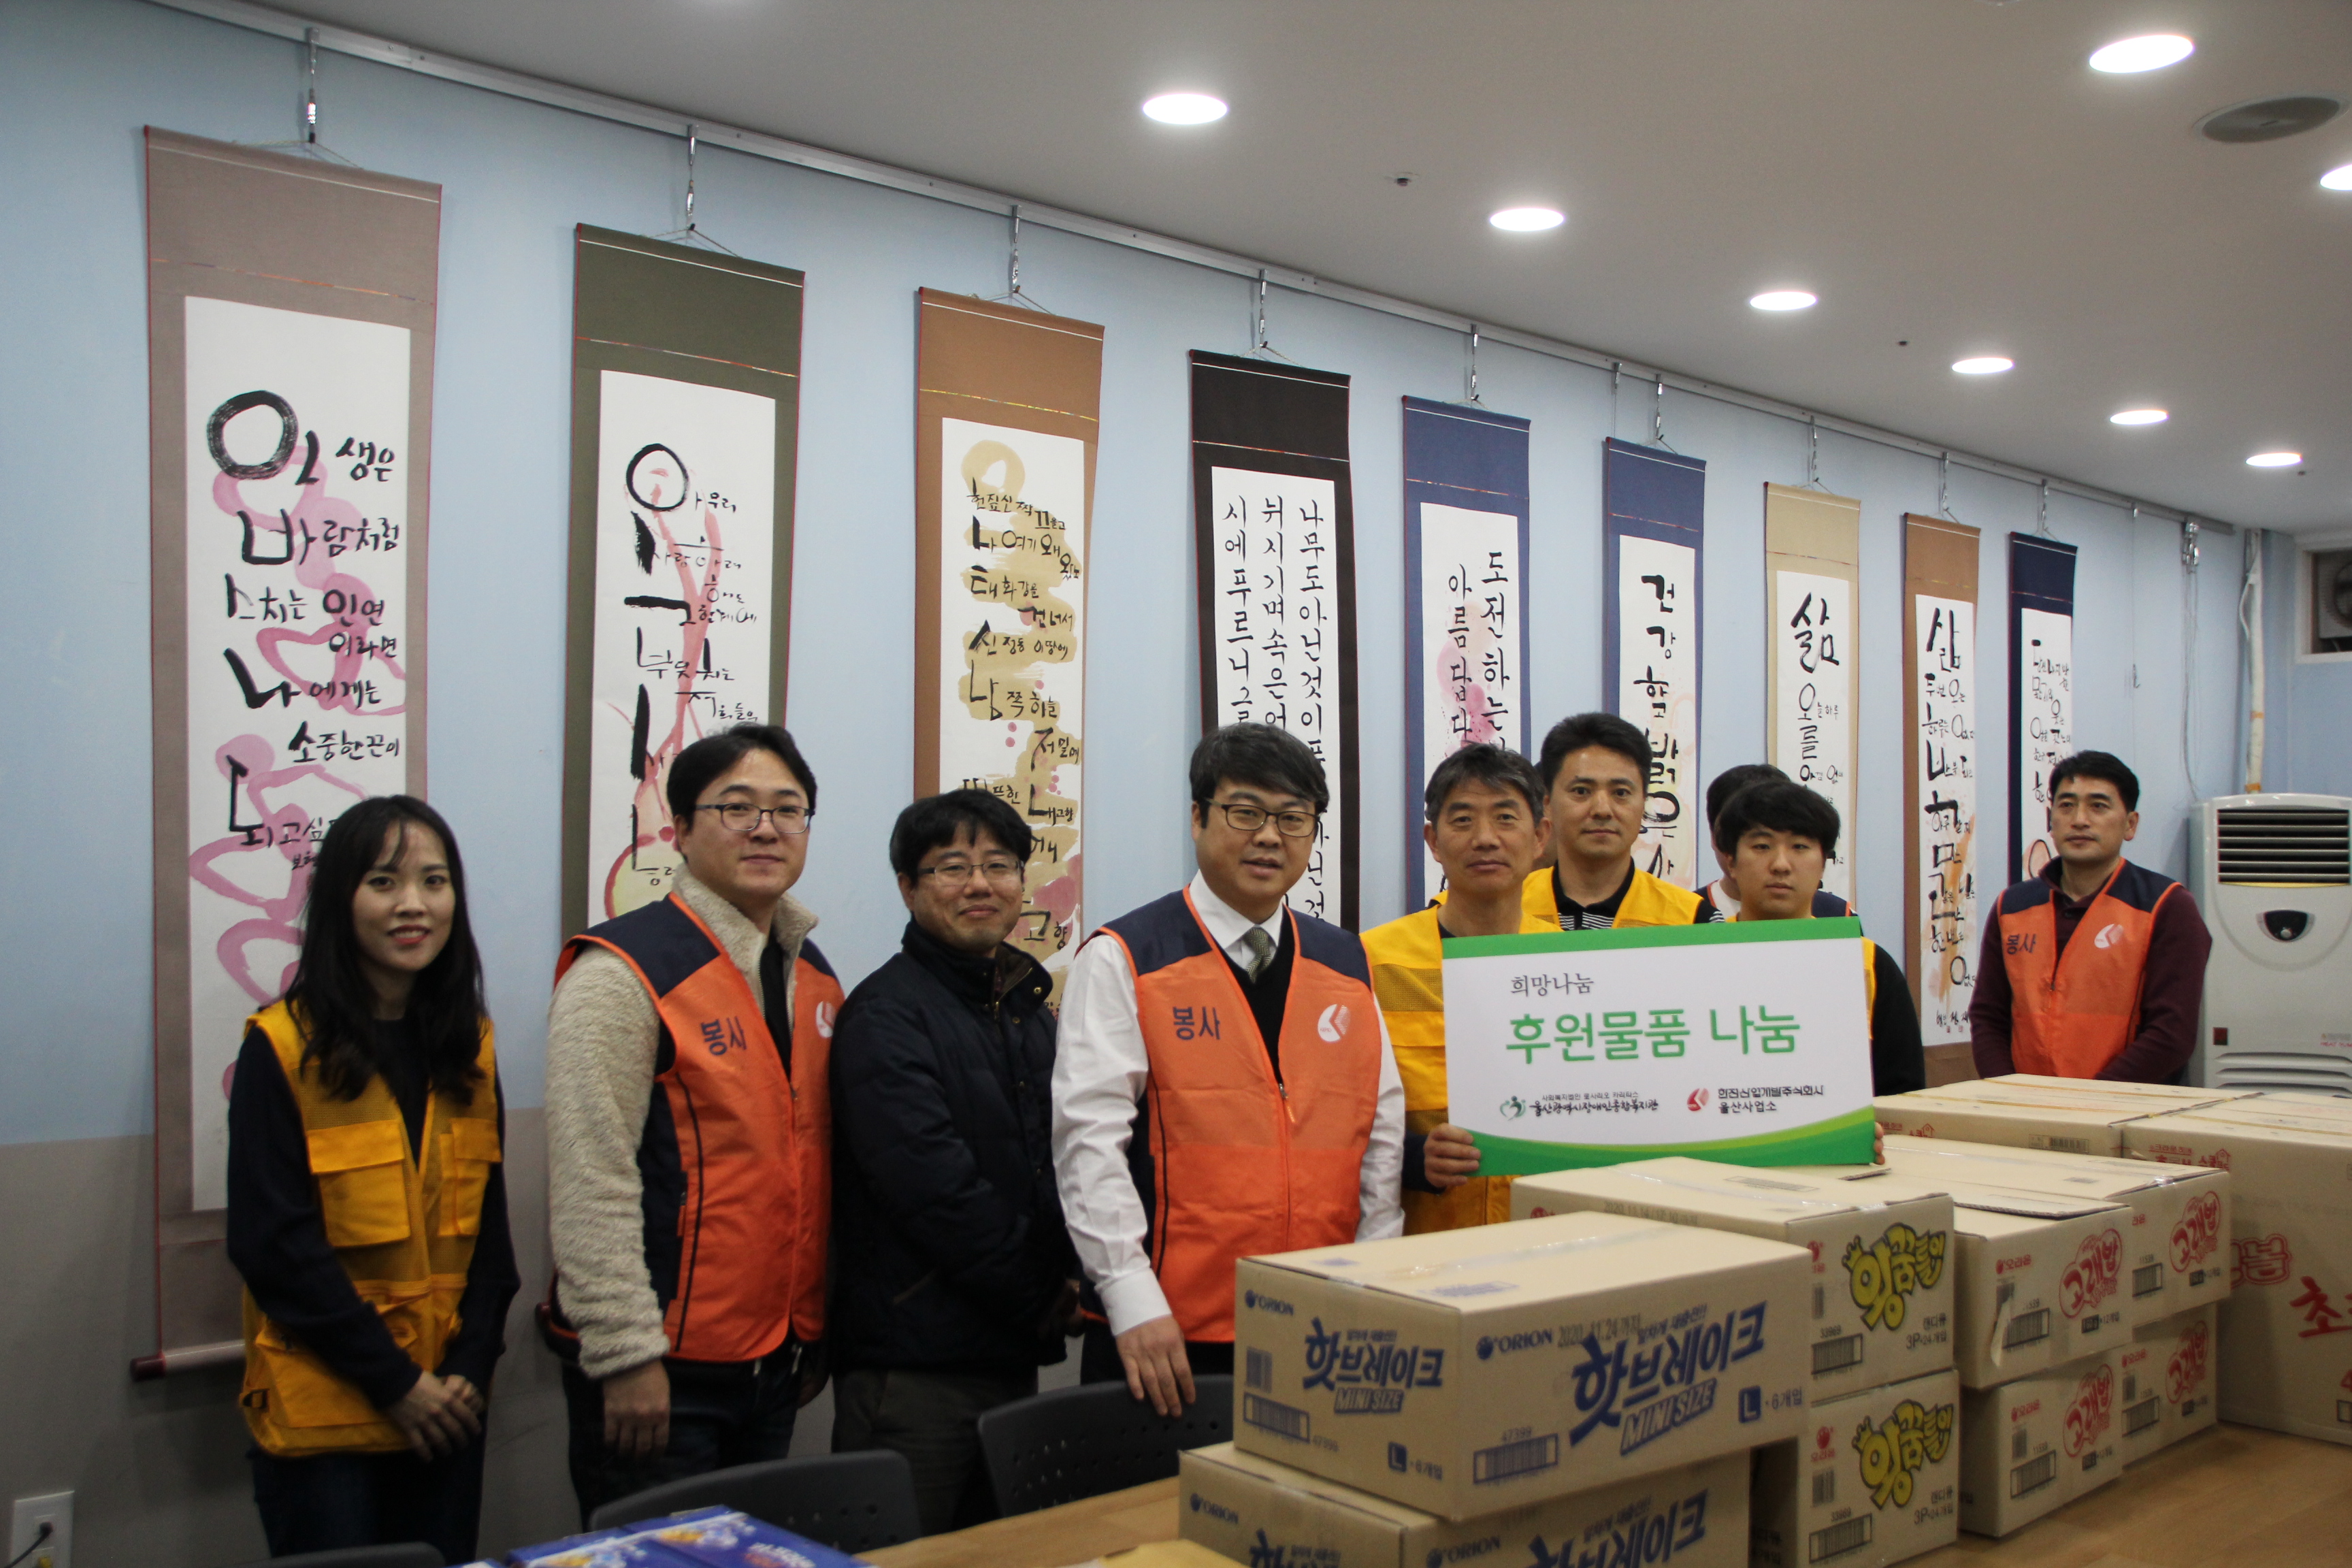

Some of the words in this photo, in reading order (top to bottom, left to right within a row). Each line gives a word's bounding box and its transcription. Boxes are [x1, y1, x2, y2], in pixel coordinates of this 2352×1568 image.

[236, 508, 400, 565] 바람처럼
[224, 573, 308, 623] 스치는
[323, 589, 385, 627] 인연
[329, 632, 397, 658] 이라면
[1791, 591, 1840, 673] 삶
[2006, 933, 2037, 956] 봉사
[1510, 972, 1595, 998] 희망나눔
[700, 1016, 747, 1056] 봉사
[1173, 1007, 1221, 1041] 봉사
[1505, 1009, 1691, 1065] 후원물품
[1710, 1005, 1801, 1056] 나눔
[1529, 1098, 1659, 1117] 울산광역시장애인종합복지관
[1718, 1100, 1778, 1114] 울산사업소
[2173, 1199, 2217, 1264] 고래밥
[2063, 1237, 2119, 1311] 고래밥
[1258, 1295, 1295, 1316] ORION
[1303, 1316, 1444, 1391] 핫브레이크
[1499, 1329, 1552, 1352] ORION
[1570, 1300, 1767, 1447] 핫브레이크
[1447, 1536, 1501, 1563] ORION
